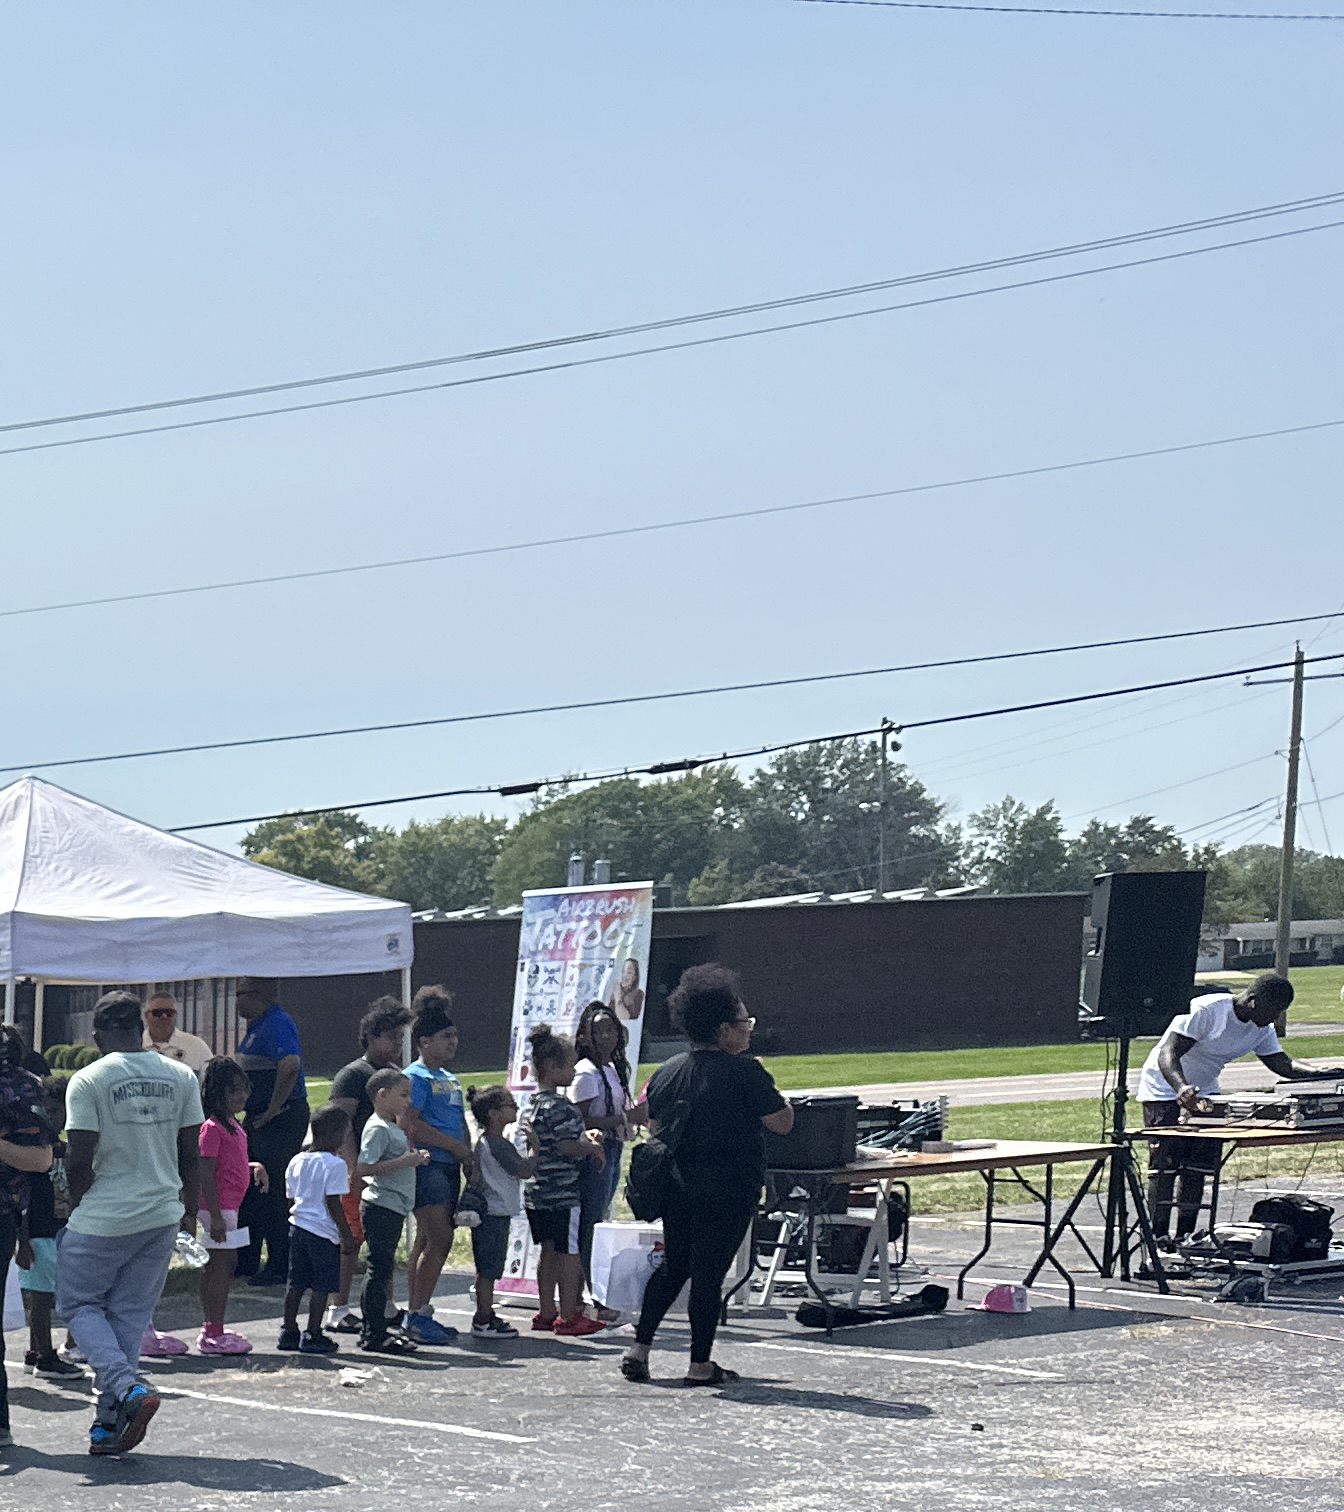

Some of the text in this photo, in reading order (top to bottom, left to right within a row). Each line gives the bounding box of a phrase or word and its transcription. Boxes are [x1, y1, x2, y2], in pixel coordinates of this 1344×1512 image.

[555, 895, 635, 918] AIRBRUSH
[526, 908, 639, 952] TATTOOS
[112, 1081, 176, 1105] MISSOURI
